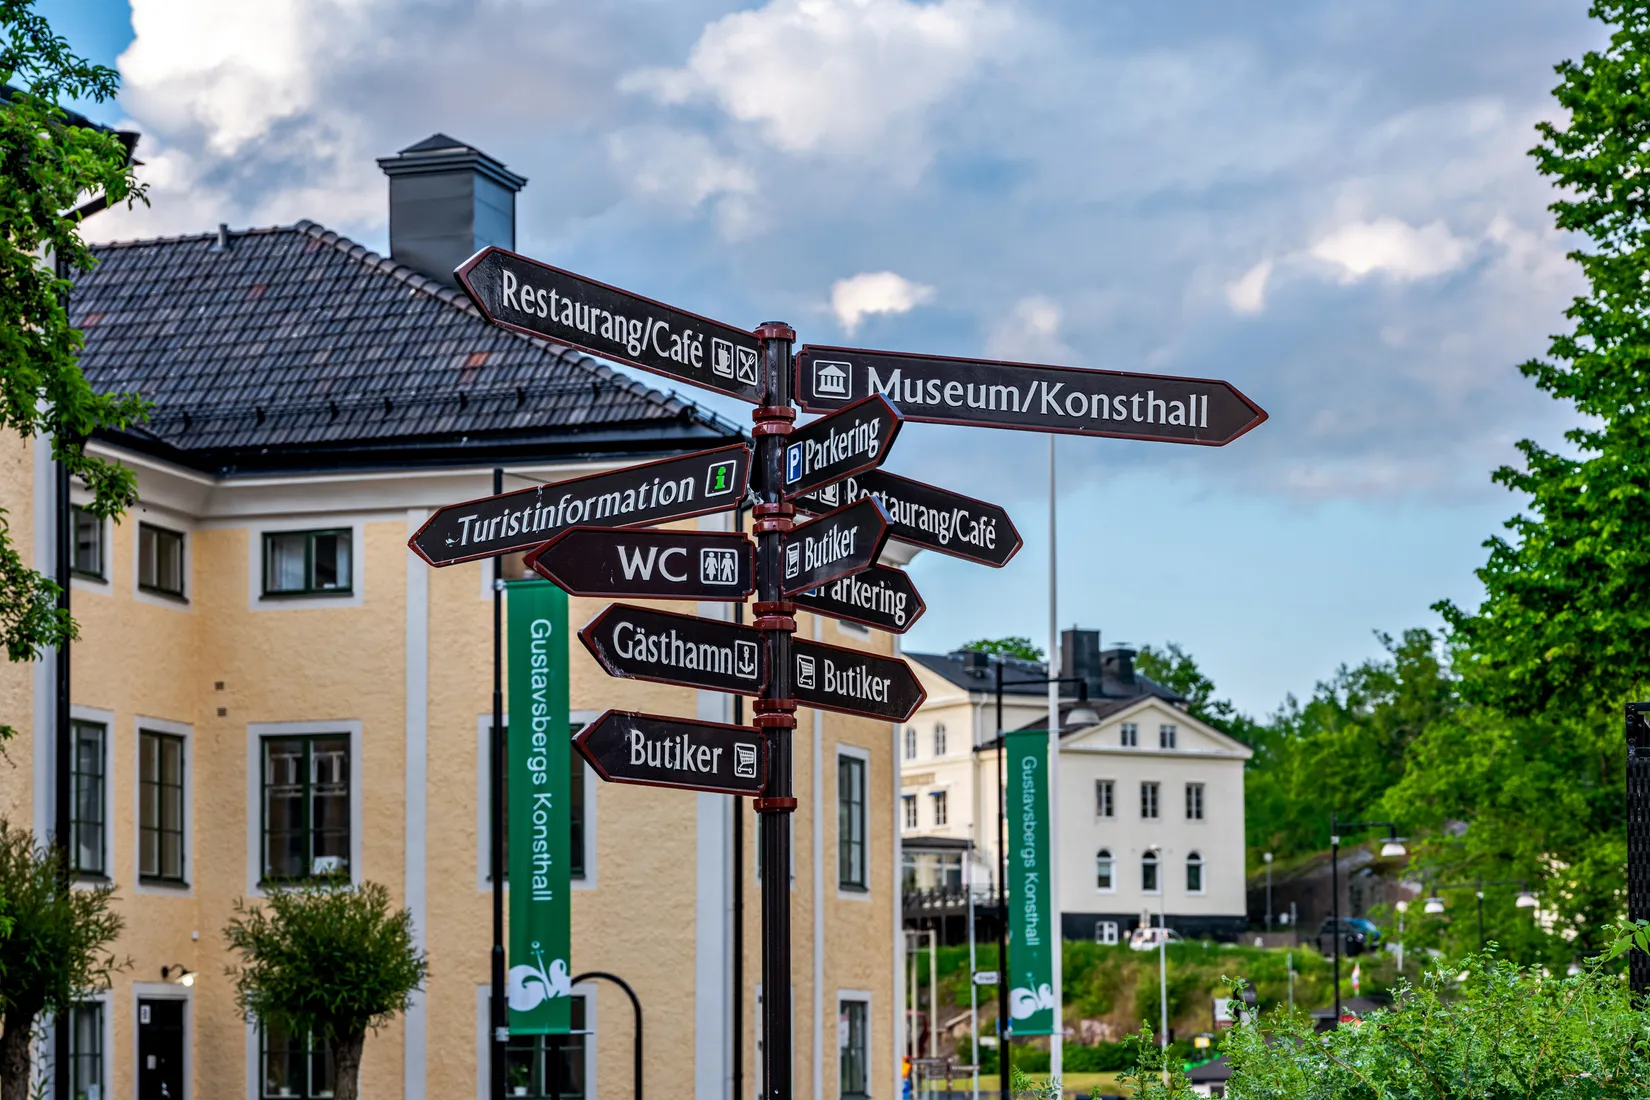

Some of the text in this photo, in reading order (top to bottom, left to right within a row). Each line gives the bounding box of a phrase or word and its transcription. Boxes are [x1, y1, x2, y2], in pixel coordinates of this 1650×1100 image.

[502, 270, 703, 368] Restaurang/Café
[867, 366, 1208, 428] Museum/Konsthall
[805, 417, 880, 475] Parkering
[458, 476, 695, 546] Turistinformation
[847, 477, 996, 549] Rtaurang/Café
[617, 545, 688, 581] WC
[805, 524, 859, 572] Butiker
[613, 622, 733, 675] Gästhamn
[824, 659, 891, 703] Butiker
[527, 619, 552, 901] Gustavsbergs Konsthall
[630, 729, 723, 774] Butiker
[1020, 756, 1040, 946] Gustavsbergs Konsthall
